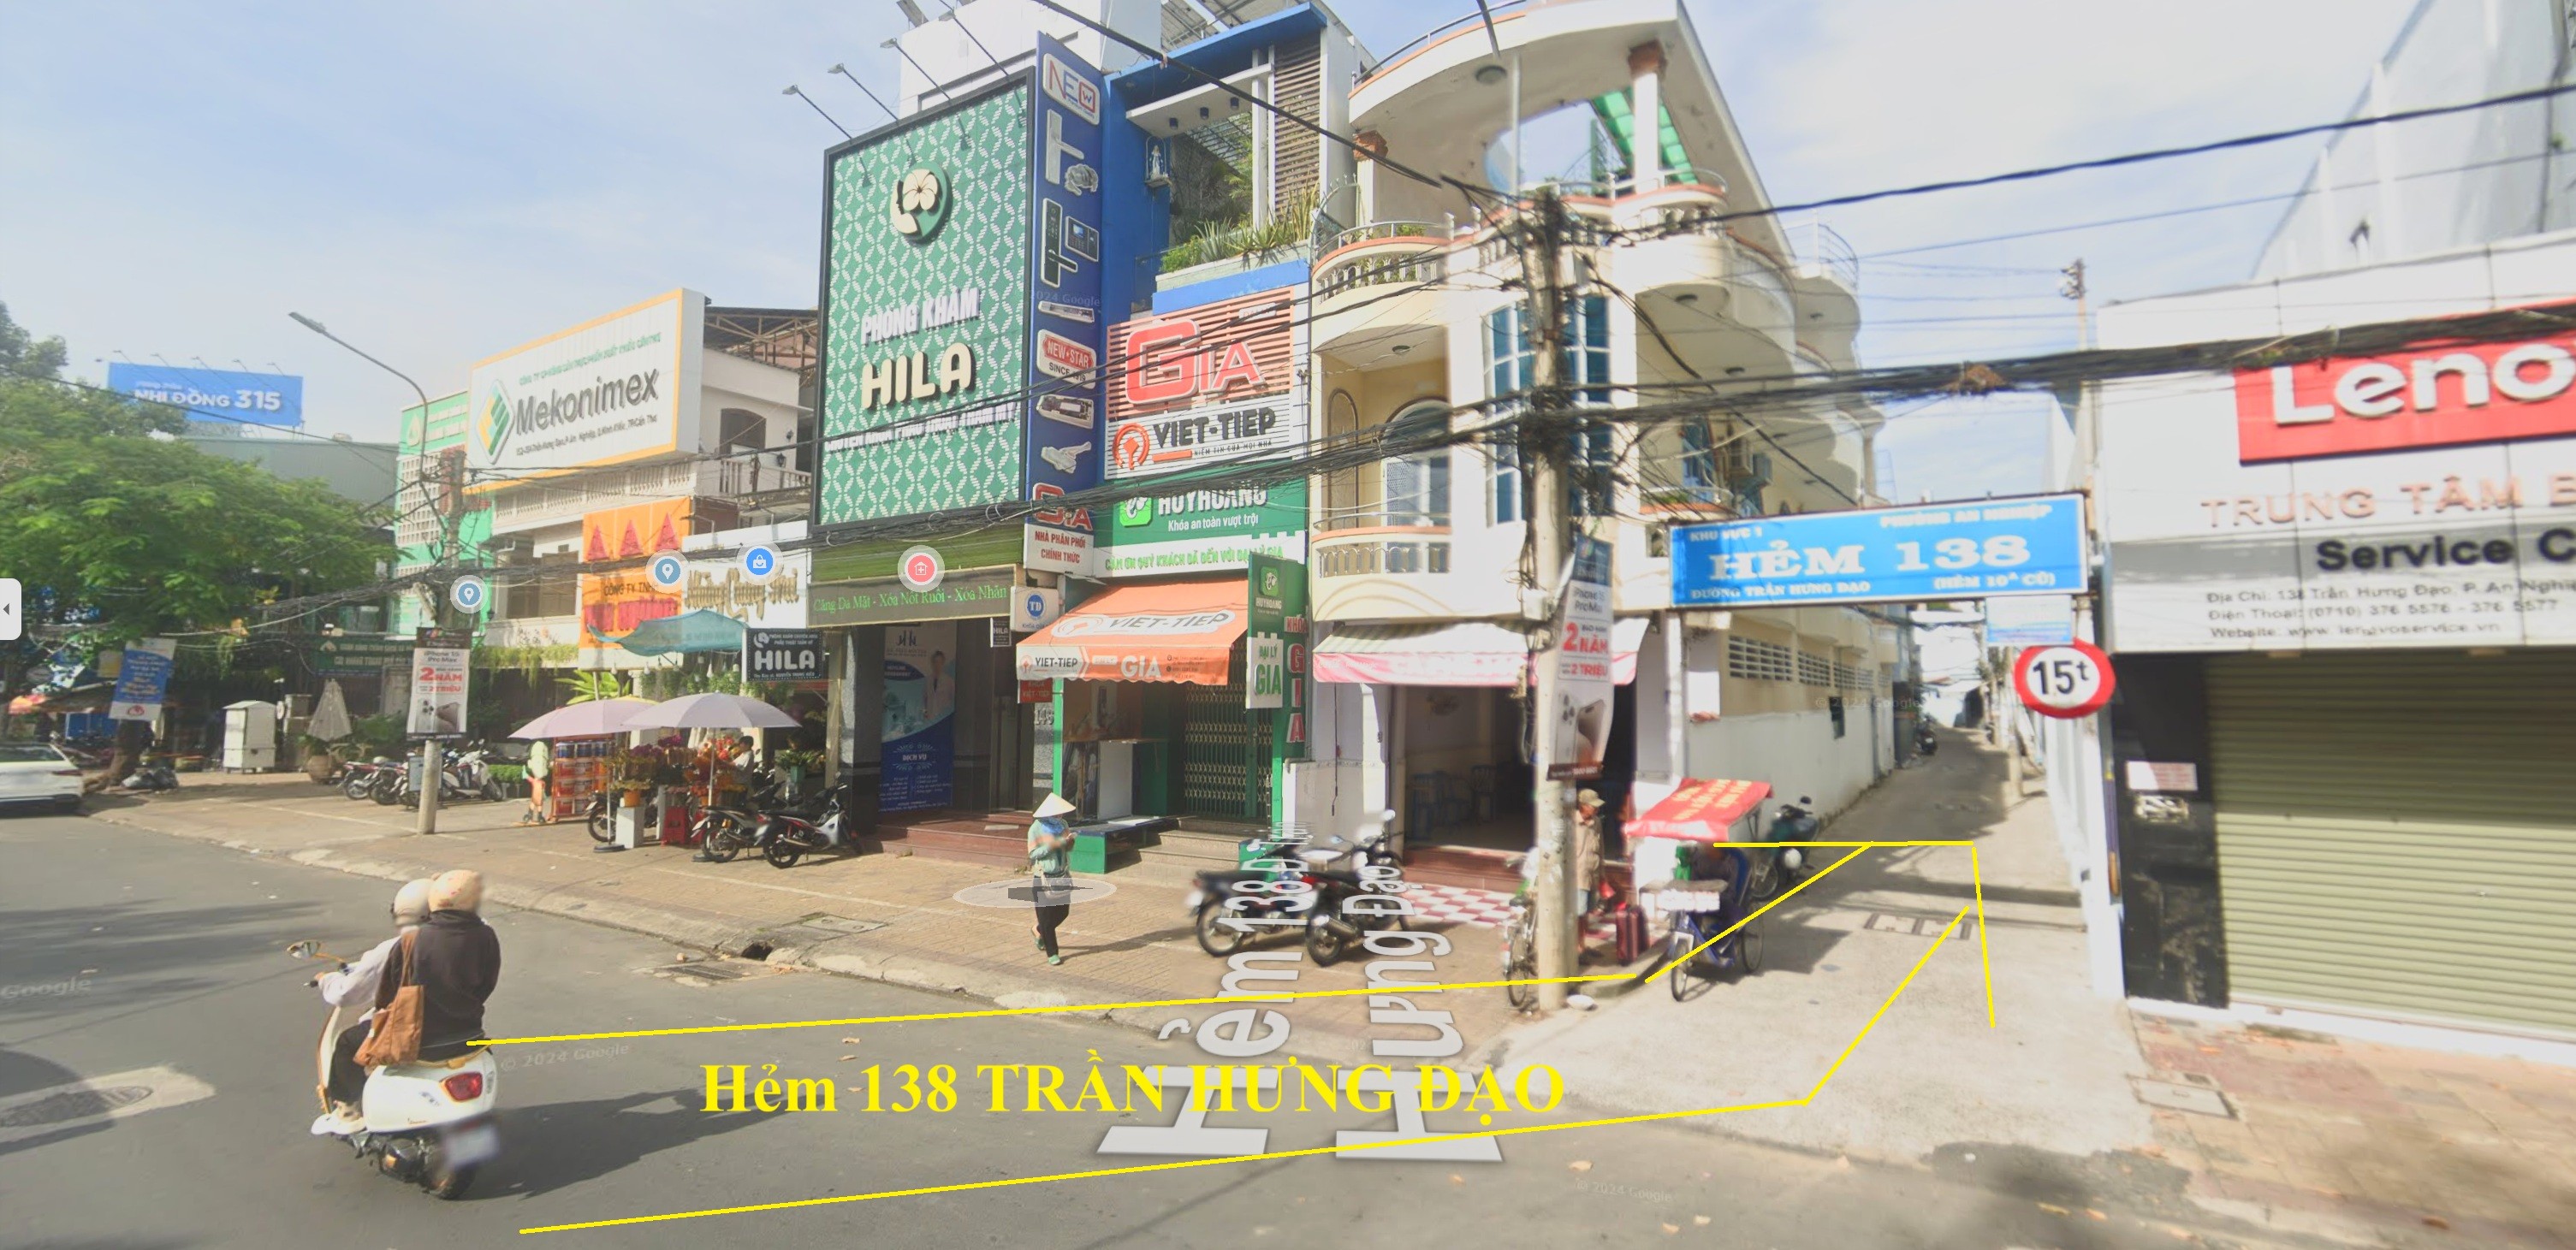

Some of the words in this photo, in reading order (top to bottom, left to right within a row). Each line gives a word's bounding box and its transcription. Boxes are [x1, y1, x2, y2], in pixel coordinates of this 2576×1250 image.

[861, 304, 919, 345] PHÒNG
[921, 287, 982, 331] KHÁM
[1047, 340, 1065, 359] NEW
[1070, 348, 1089, 370] STAR
[1126, 318, 1266, 406] GIA
[861, 343, 975, 411] HILA
[134, 388, 169, 403] NHI
[234, 389, 281, 412] 315
[516, 368, 660, 436] Mekonimex
[2200, 488, 2376, 528] TRUNG
[2401, 475, 2524, 515] TÂM
[1167, 518, 1190, 532] Khóa
[1191, 519, 1202, 530] an
[1202, 515, 1221, 529] toàn
[1223, 514, 1241, 528] vượt
[1243, 512, 1259, 526] trội
[1690, 530, 1719, 542] KHU
[1755, 525, 1763, 538] 1
[1035, 530, 1049, 542] NHÀ
[1051, 532, 1070, 546] PHÂN
[1071, 535, 1086, 548] PHỐI
[1041, 548, 1062, 562] CHÍNH
[1063, 551, 1081, 564] THỨC
[1710, 540, 1866, 581] HẺM
[1896, 534, 2032, 572] 138
[2316, 534, 2515, 572] Service
[838, 597, 851, 611] Da
[854, 595, 871, 609] Mặt
[879, 593, 899, 607] Xóa
[921, 589, 945, 605] Ruồi
[953, 587, 976, 602] Xóa
[1744, 581, 1785, 597] TRẦN
[1837, 581, 1871, 595] ĐẠO
[2311, 585, 2348, 600] Trần
[2485, 581, 2514, 594] An
[1029, 601, 1042, 612] TD
[1562, 621, 1579, 652] 2
[754, 650, 816, 671] HILA
[1035, 656, 1078, 668] VIET-TIEP
[1259, 645, 1271, 661] ĐẠI
[1271, 644, 1278, 658] LÝ
[418, 666, 435, 682] 2
[435, 672, 463, 682] NĂM
[1121, 655, 1161, 678] GIA
[1570, 663, 1579, 675] 2
[2033, 660, 2090, 695] 15t
[1255, 663, 1282, 696] GIA
[1286, 643, 1305, 743] GIA
